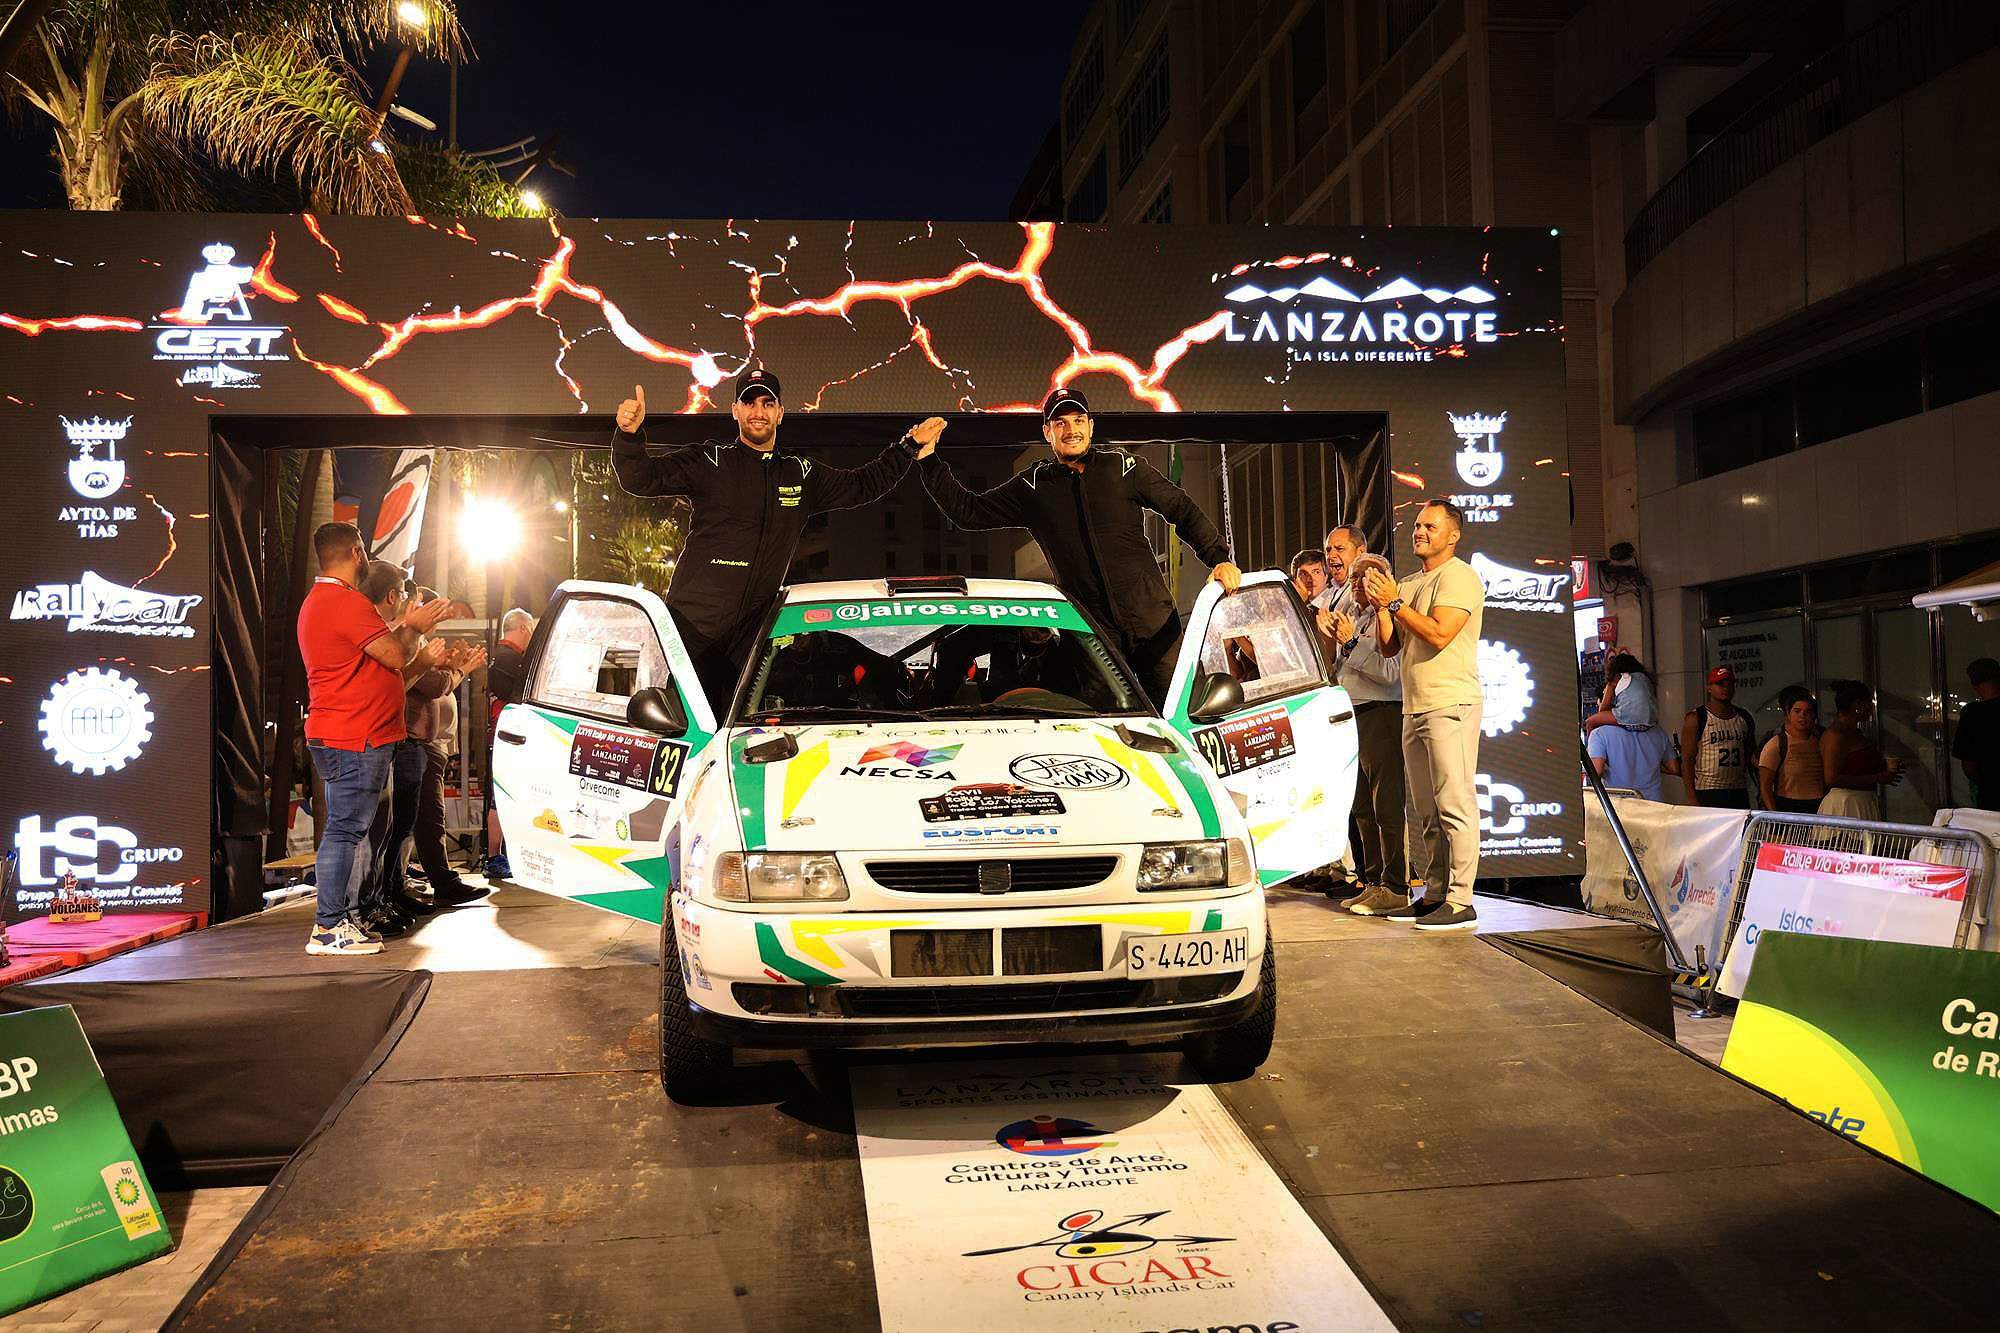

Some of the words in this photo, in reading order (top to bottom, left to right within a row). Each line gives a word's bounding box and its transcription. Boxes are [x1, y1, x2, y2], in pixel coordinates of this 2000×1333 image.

[1225, 311, 1498, 343] LANZAROTE
[156, 329, 284, 355] CERT
[1294, 351, 1312, 362] LA
[1317, 351, 1349, 362] ISLA
[1355, 351, 1433, 362] DIFERENTE
[1492, 494, 1514, 507] DE
[58, 507, 111, 521] AYTO.
[113, 506, 137, 521] DE
[77, 520, 119, 538] TÍAS
[835, 602, 1060, 621] @jairos.sport
[592, 749, 630, 764] LANZAROTE
[1200, 731, 1227, 775] 32
[654, 745, 681, 794] 32
[838, 766, 957, 781] NECSA
[1509, 803, 1562, 816] GRUPO
[121, 847, 183, 864] GRUPO
[132, 884, 183, 899] Canarias
[1686, 882, 1717, 907] Arrecife
[51, 904, 99, 914] VOLCANES
[1779, 908, 1814, 932] Islas
[1932, 1046, 1969, 1073] de
[1976, 1051, 2000, 1078] R
[897, 1075, 1159, 1097] LANZAROTE
[901, 1095, 994, 1108] SPORTS
[1004, 1086, 1167, 1102] DESTINATION
[944, 1170, 1051, 1184] Cultura
[1056, 1169, 1071, 1180] y
[1075, 1162, 1189, 1177] Turismo
[951, 1160, 1061, 1174] Centros
[1068, 1157, 1101, 1167] de
[1109, 1154, 1173, 1165] Arte,
[1007, 1177, 1140, 1193] LANZAROTE
[1016, 1256, 1234, 1291] CICAR
[1024, 1286, 1106, 1304] Canary
[1112, 1281, 1192, 1298] Islands
[1196, 1278, 1237, 1290] Car
